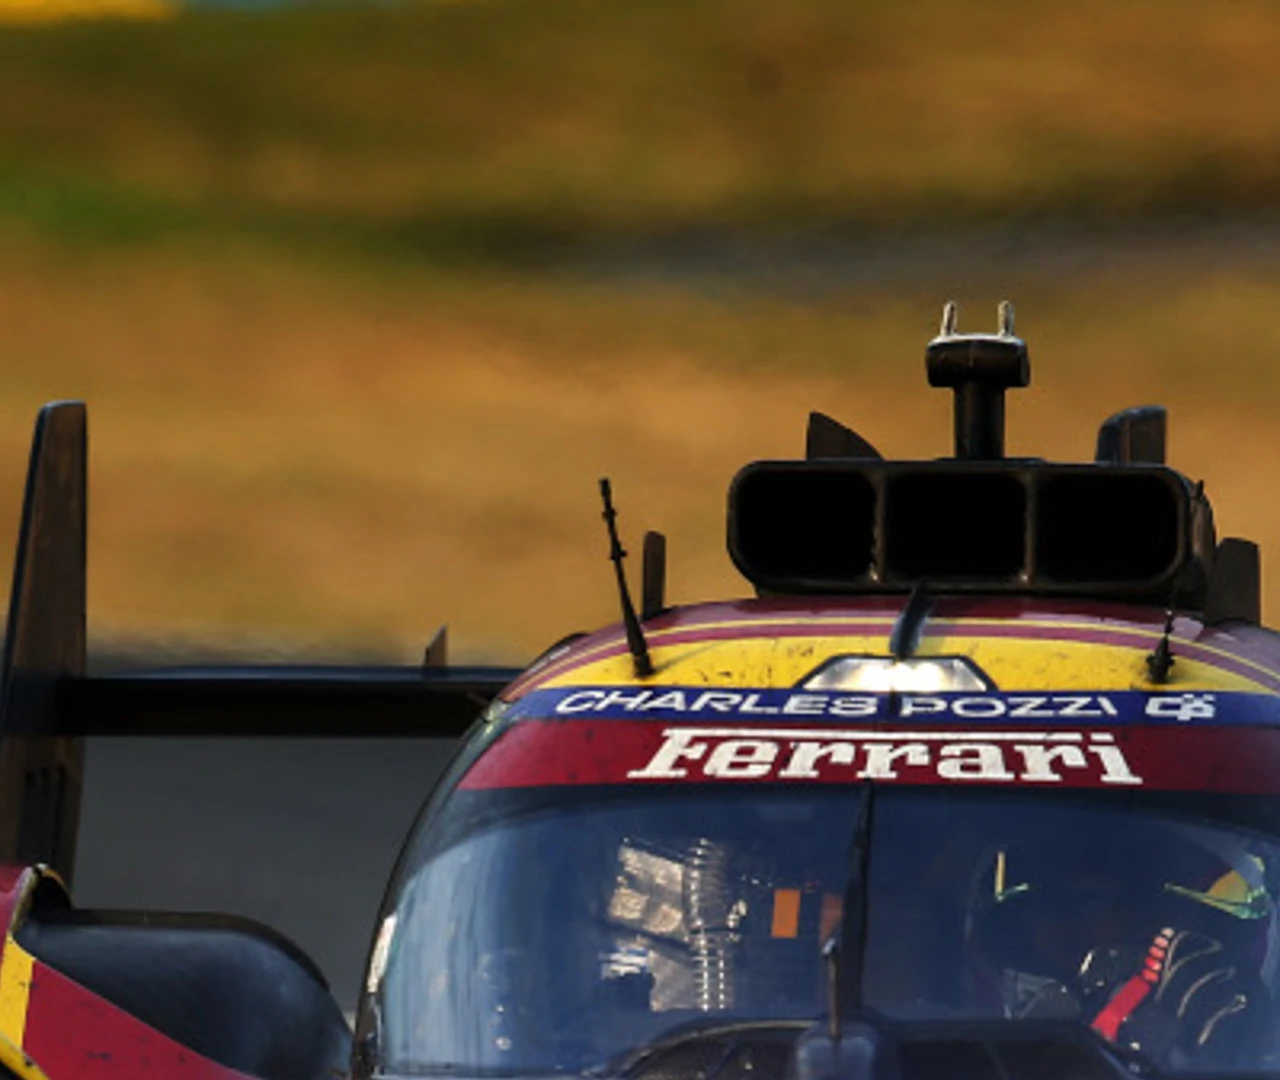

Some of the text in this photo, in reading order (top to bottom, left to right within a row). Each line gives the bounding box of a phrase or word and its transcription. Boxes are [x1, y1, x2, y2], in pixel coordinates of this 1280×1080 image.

[554, 690, 878, 716] CHARLES
[899, 696, 1118, 718] POZZI
[626, 727, 1143, 785] Ferrari
